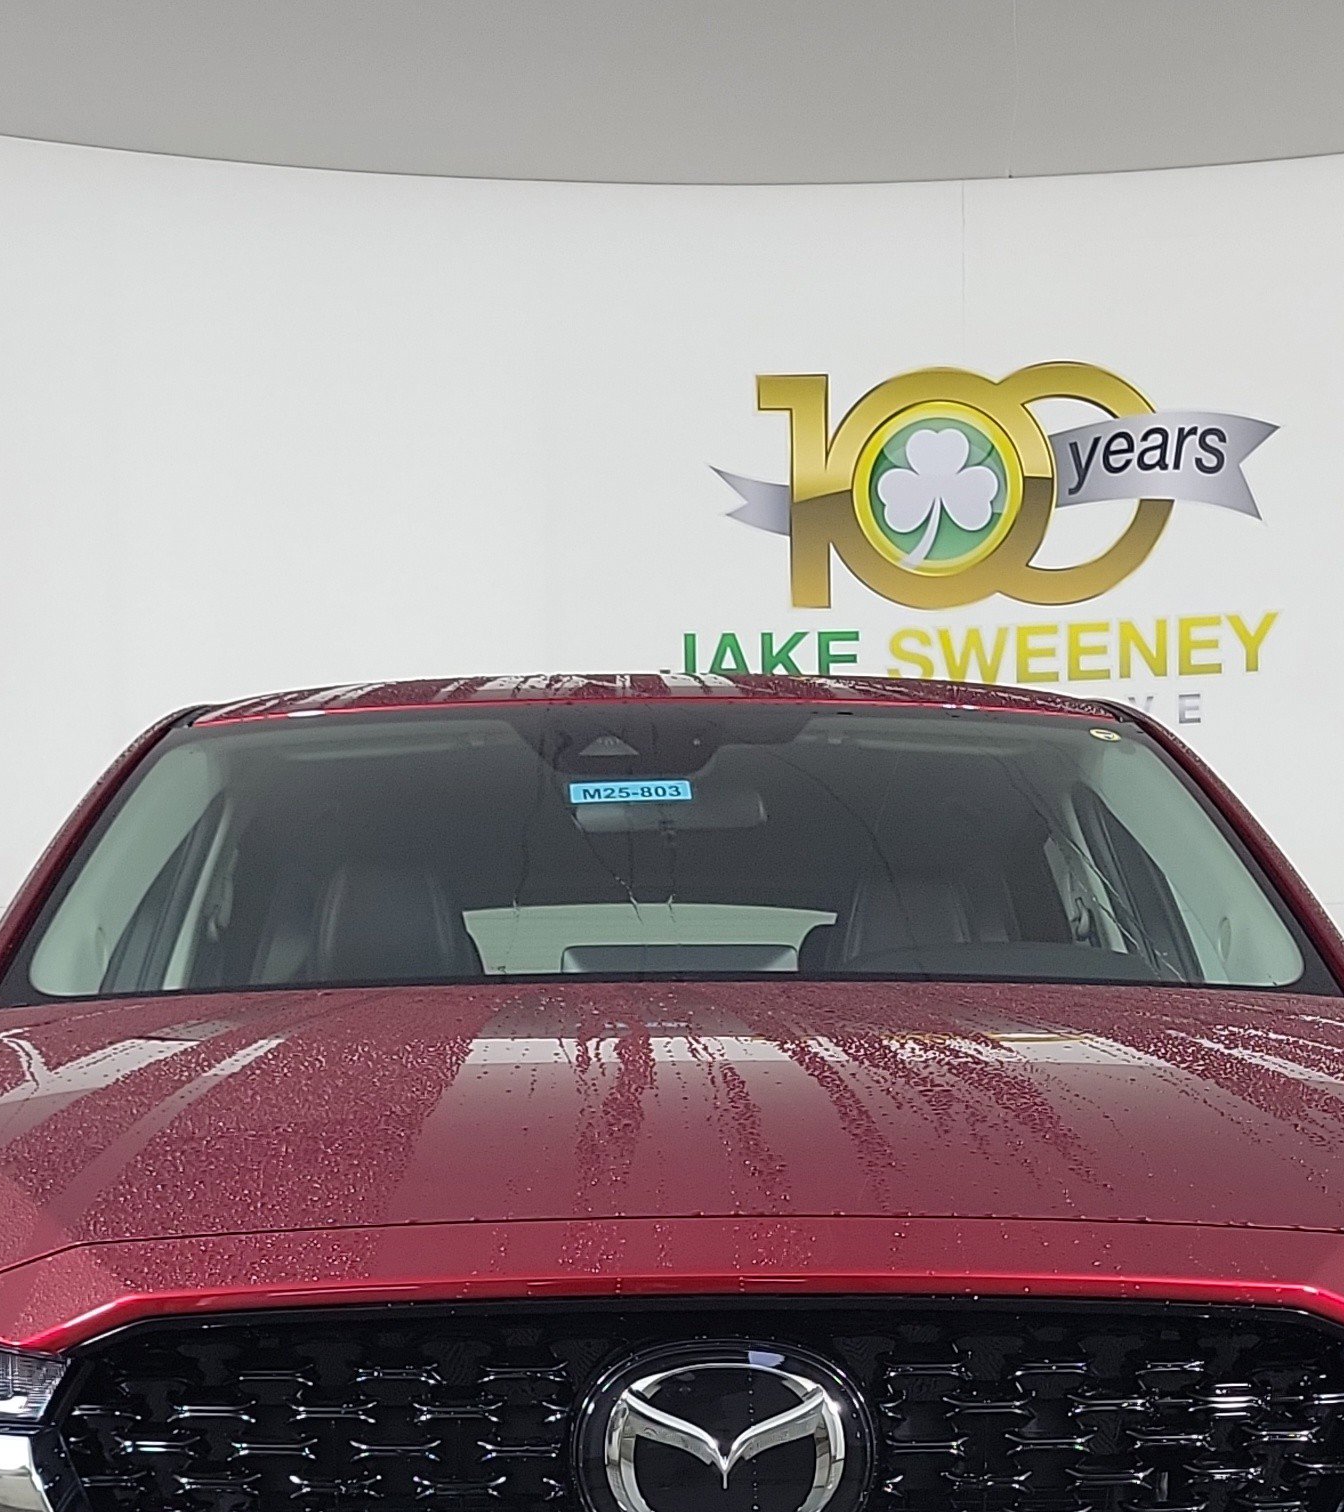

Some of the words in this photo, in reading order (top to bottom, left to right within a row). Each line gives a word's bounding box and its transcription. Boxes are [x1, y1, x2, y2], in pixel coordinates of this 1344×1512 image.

[756, 361, 1175, 610] 100
[1067, 423, 1228, 497] years
[886, 612, 1279, 684] SWEENEY
[582, 785, 682, 800] M25-803
